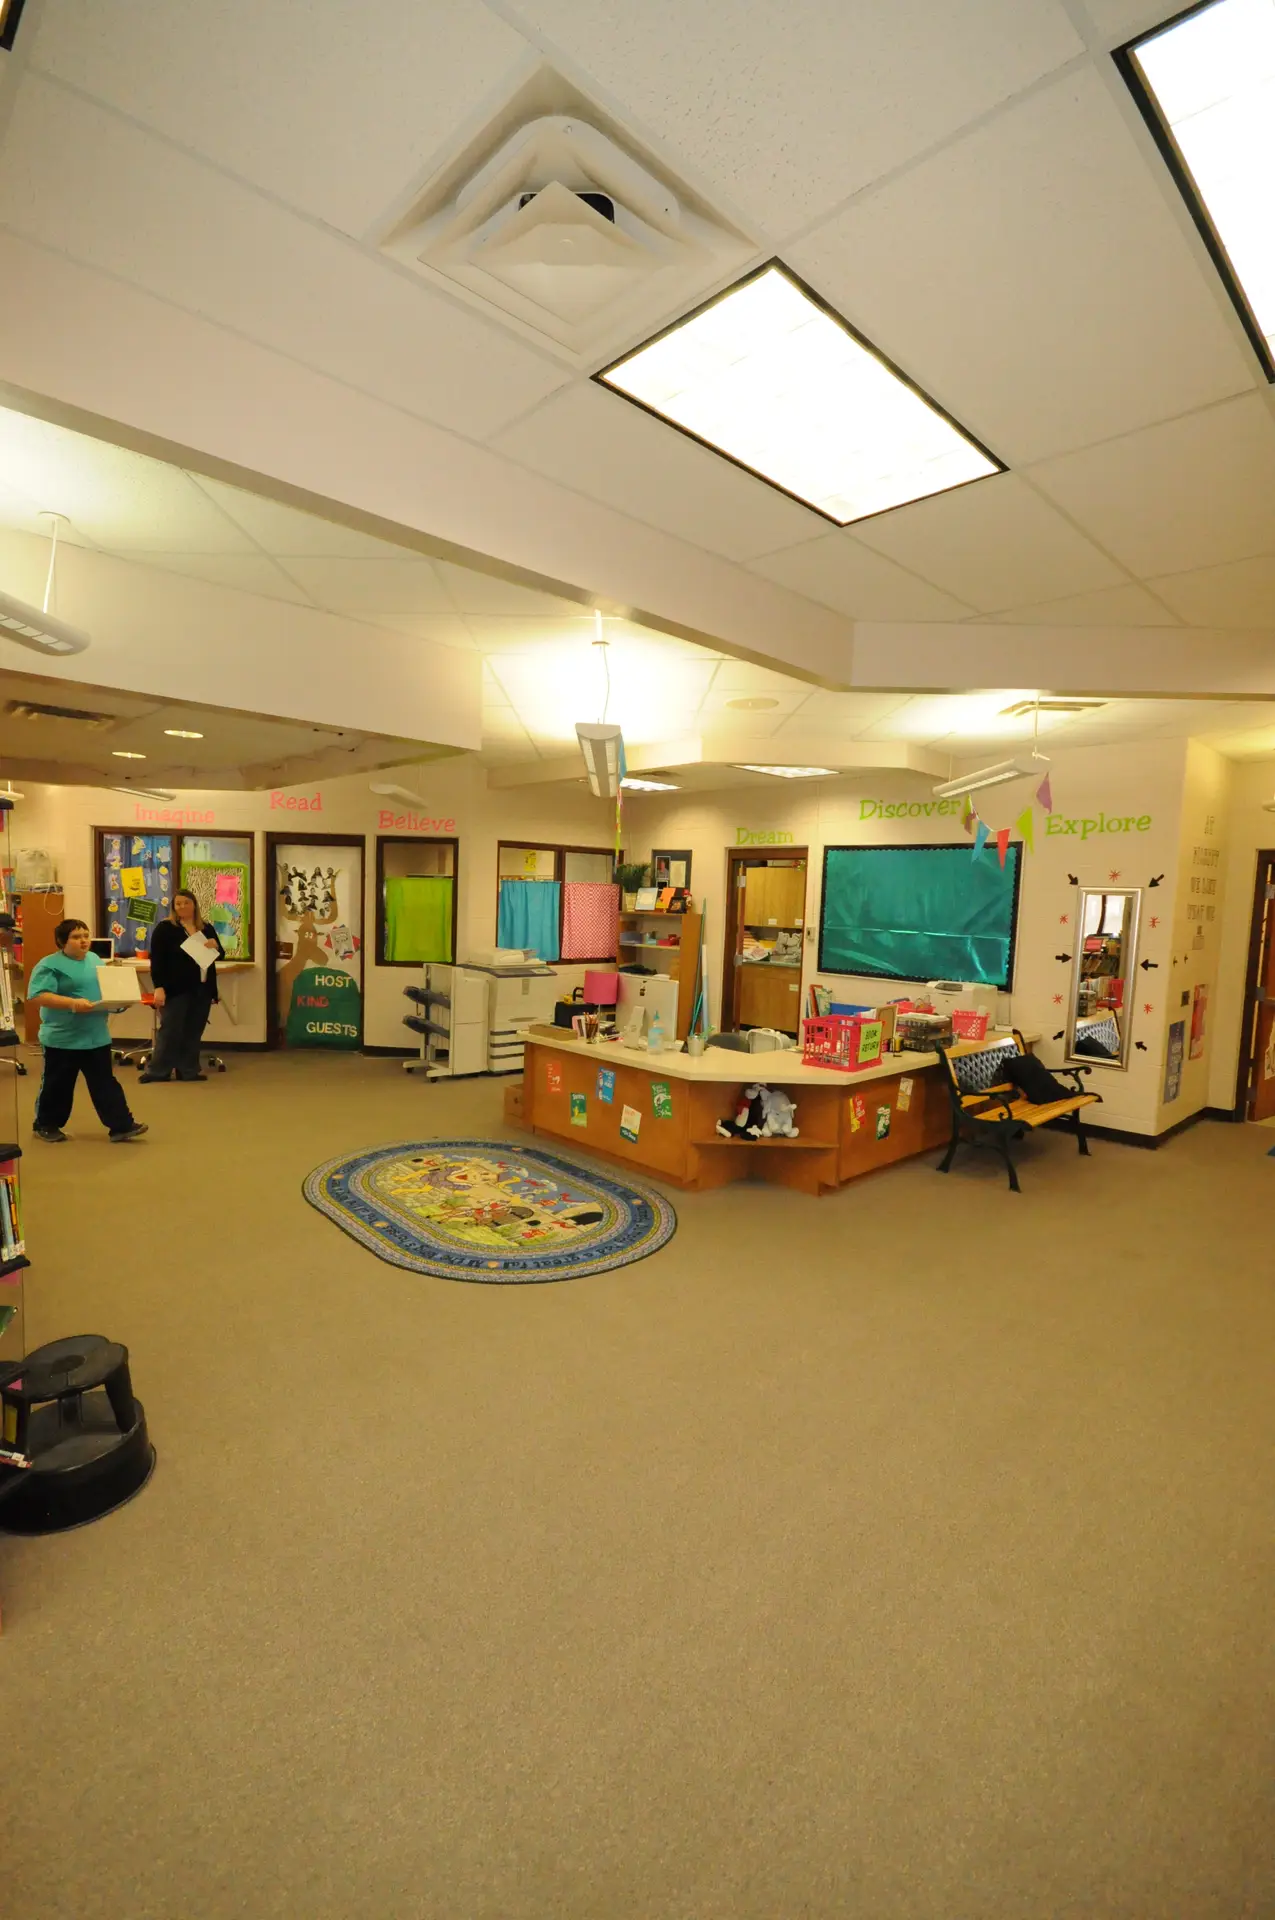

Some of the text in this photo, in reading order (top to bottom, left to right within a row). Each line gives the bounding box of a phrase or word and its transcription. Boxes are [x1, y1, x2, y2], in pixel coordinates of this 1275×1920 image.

[270, 791, 323, 812] Read
[859, 798, 963, 821] Discover
[134, 803, 216, 829] Imagine
[378, 810, 457, 833] Believe
[1045, 811, 1152, 840] Explore
[736, 826, 794, 845] Dream
[315, 975, 353, 988] HOST
[296, 995, 329, 1008] KIND
[306, 1022, 358, 1038] GUESTS
[865, 1029, 878, 1040] BOOK
[861, 1040, 879, 1053] RETURN
